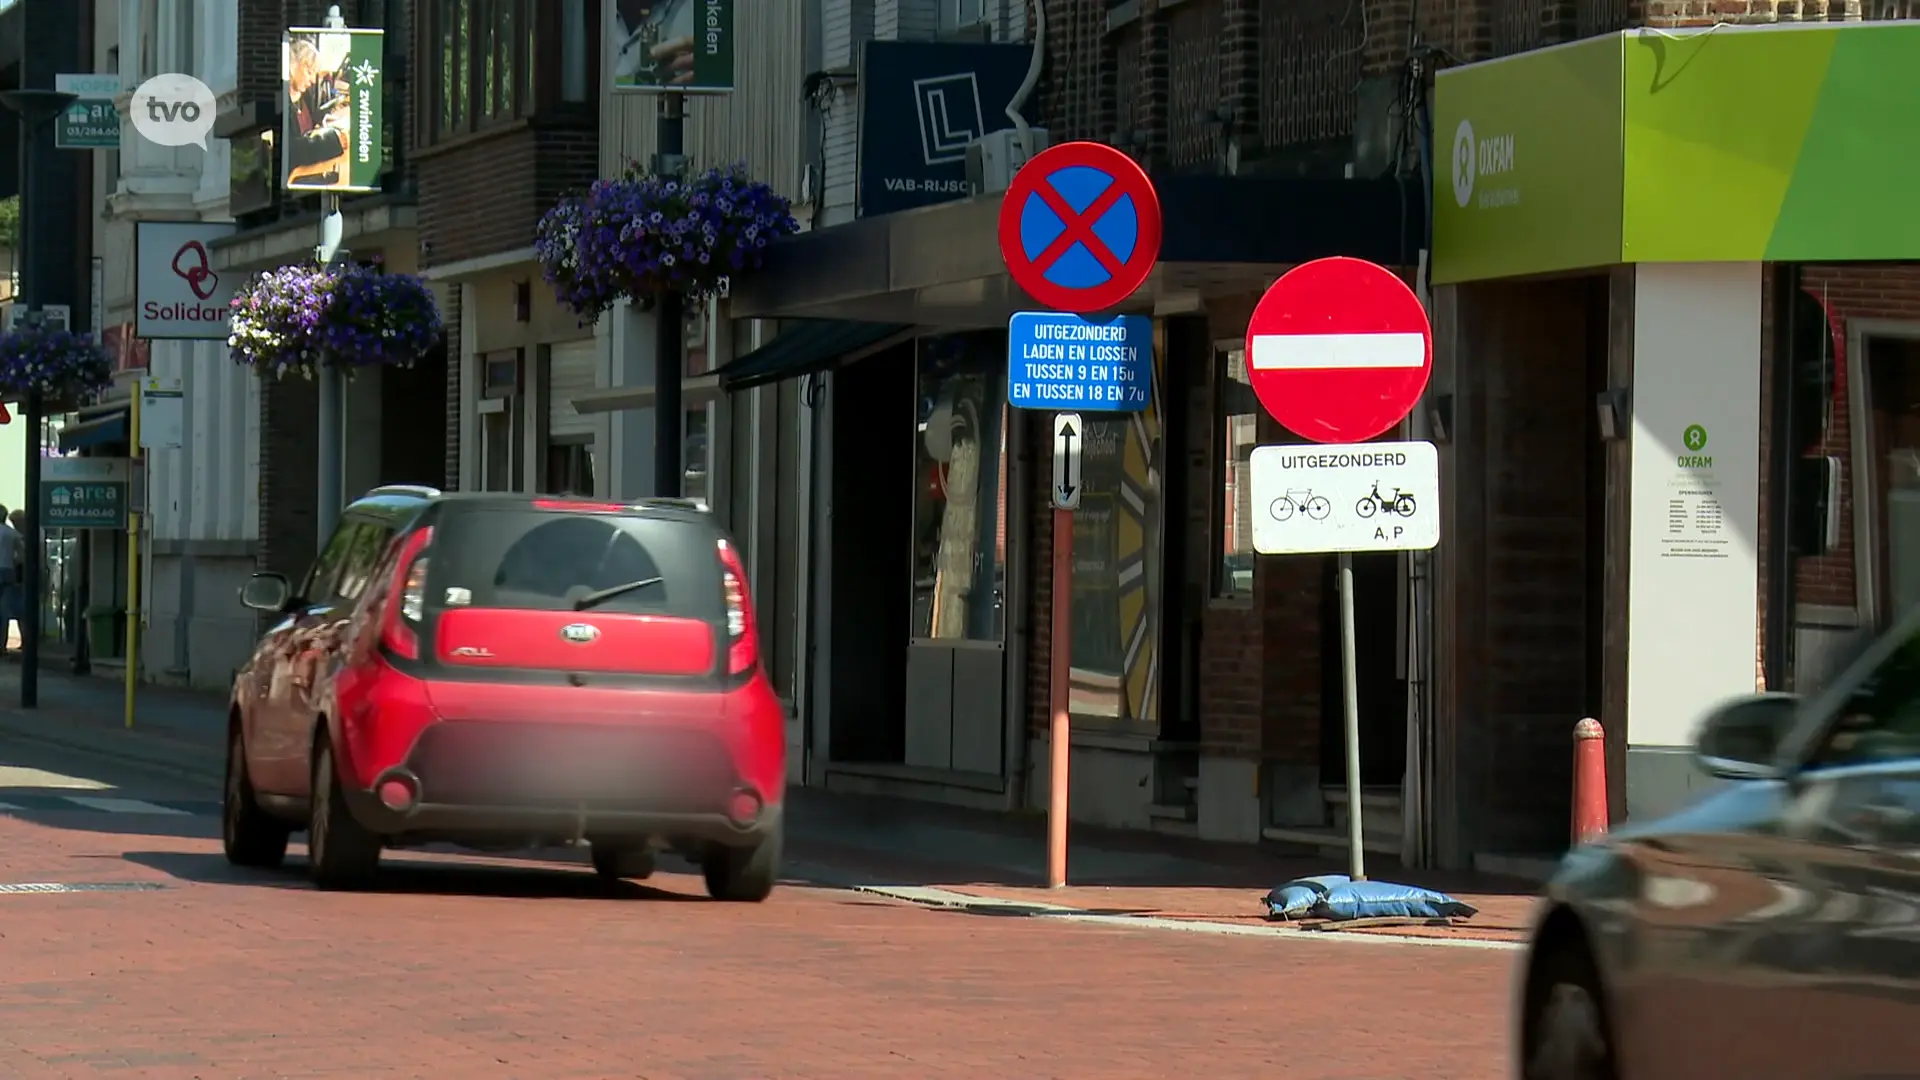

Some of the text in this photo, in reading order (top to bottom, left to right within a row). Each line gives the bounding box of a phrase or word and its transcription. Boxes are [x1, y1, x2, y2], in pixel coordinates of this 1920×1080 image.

[359, 89, 373, 163] zwinkelen
[1479, 133, 1515, 176] OXFAM
[1034, 324, 1127, 342] UITGEZONDERD
[1023, 343, 1137, 362] LADEN EN LOSSEN
[1025, 363, 1135, 382] TUSSEN 9 EN 15u
[1013, 383, 1145, 402] EN TUSSEN 18 EN 7u
[1281, 453, 1406, 469] UITGEZONDERD
[1677, 456, 1713, 468] OXFAM
[73, 486, 117, 500] area
[1374, 526, 1404, 542] A, P
